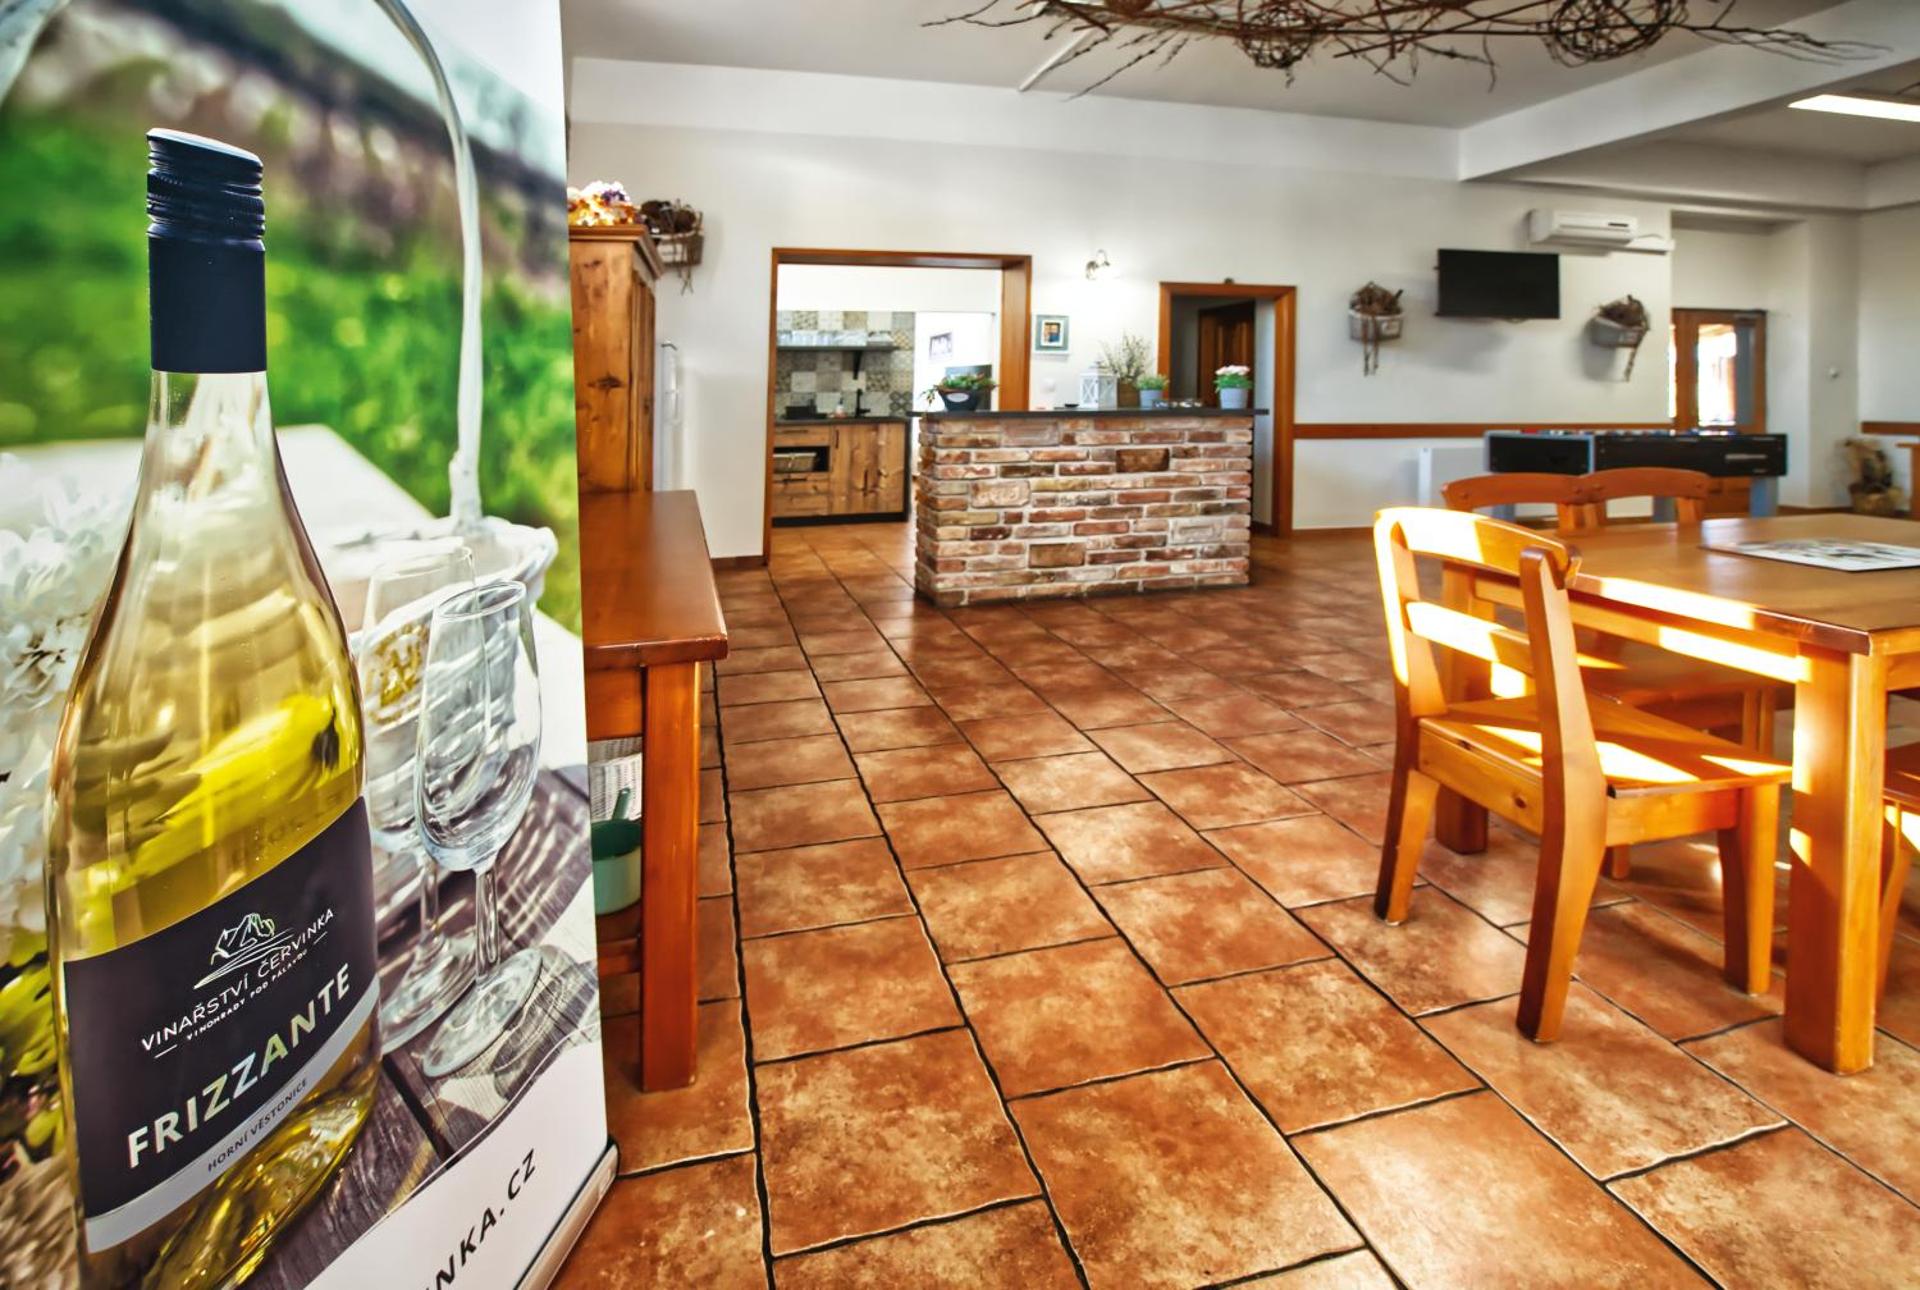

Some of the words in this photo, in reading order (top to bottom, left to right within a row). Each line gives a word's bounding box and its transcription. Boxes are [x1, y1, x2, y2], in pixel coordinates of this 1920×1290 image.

[141, 973, 249, 1051] VINAŘSTVÍ
[258, 908, 334, 977] ČERVINKA
[186, 998, 246, 1041] VINOHRADY
[250, 981, 269, 998] POD
[127, 962, 351, 1169] FRIZZANTE
[207, 1131, 249, 1172] HORNÍ
[426, 1148, 536, 1290] NKA.CZ
